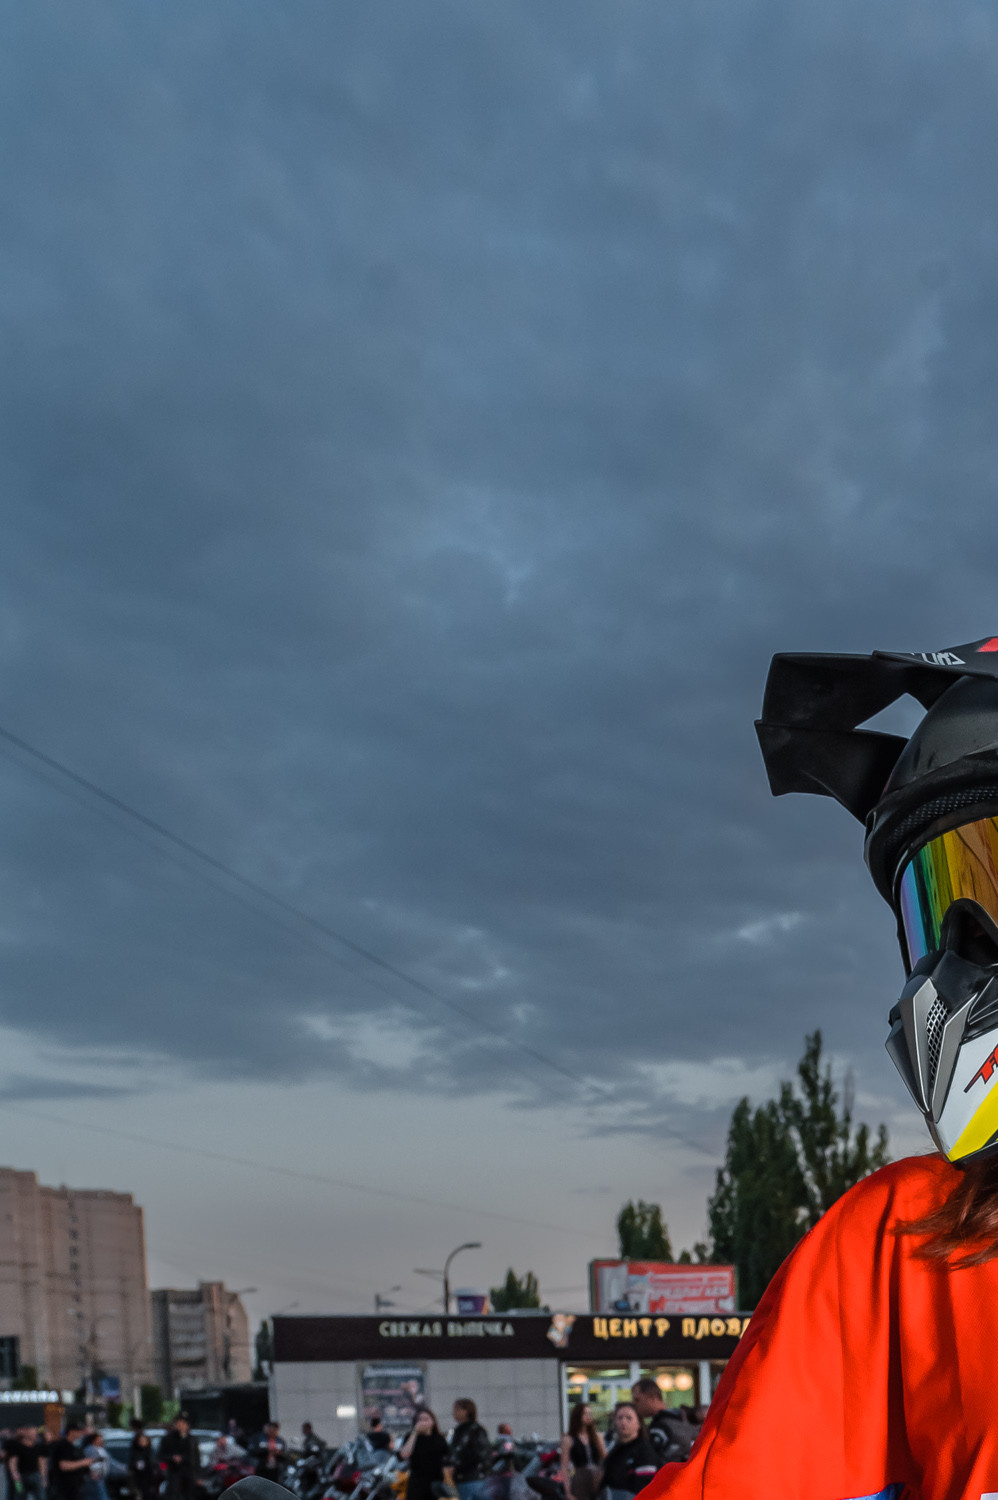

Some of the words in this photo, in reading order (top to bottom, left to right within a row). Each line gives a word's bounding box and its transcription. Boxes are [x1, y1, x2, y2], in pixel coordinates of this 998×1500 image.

[379, 1321, 442, 1337] СВЕЖАЯ
[446, 1321, 515, 1337] ВЫПЕЧКА
[593, 1317, 670, 1340] ЦЕНТР
